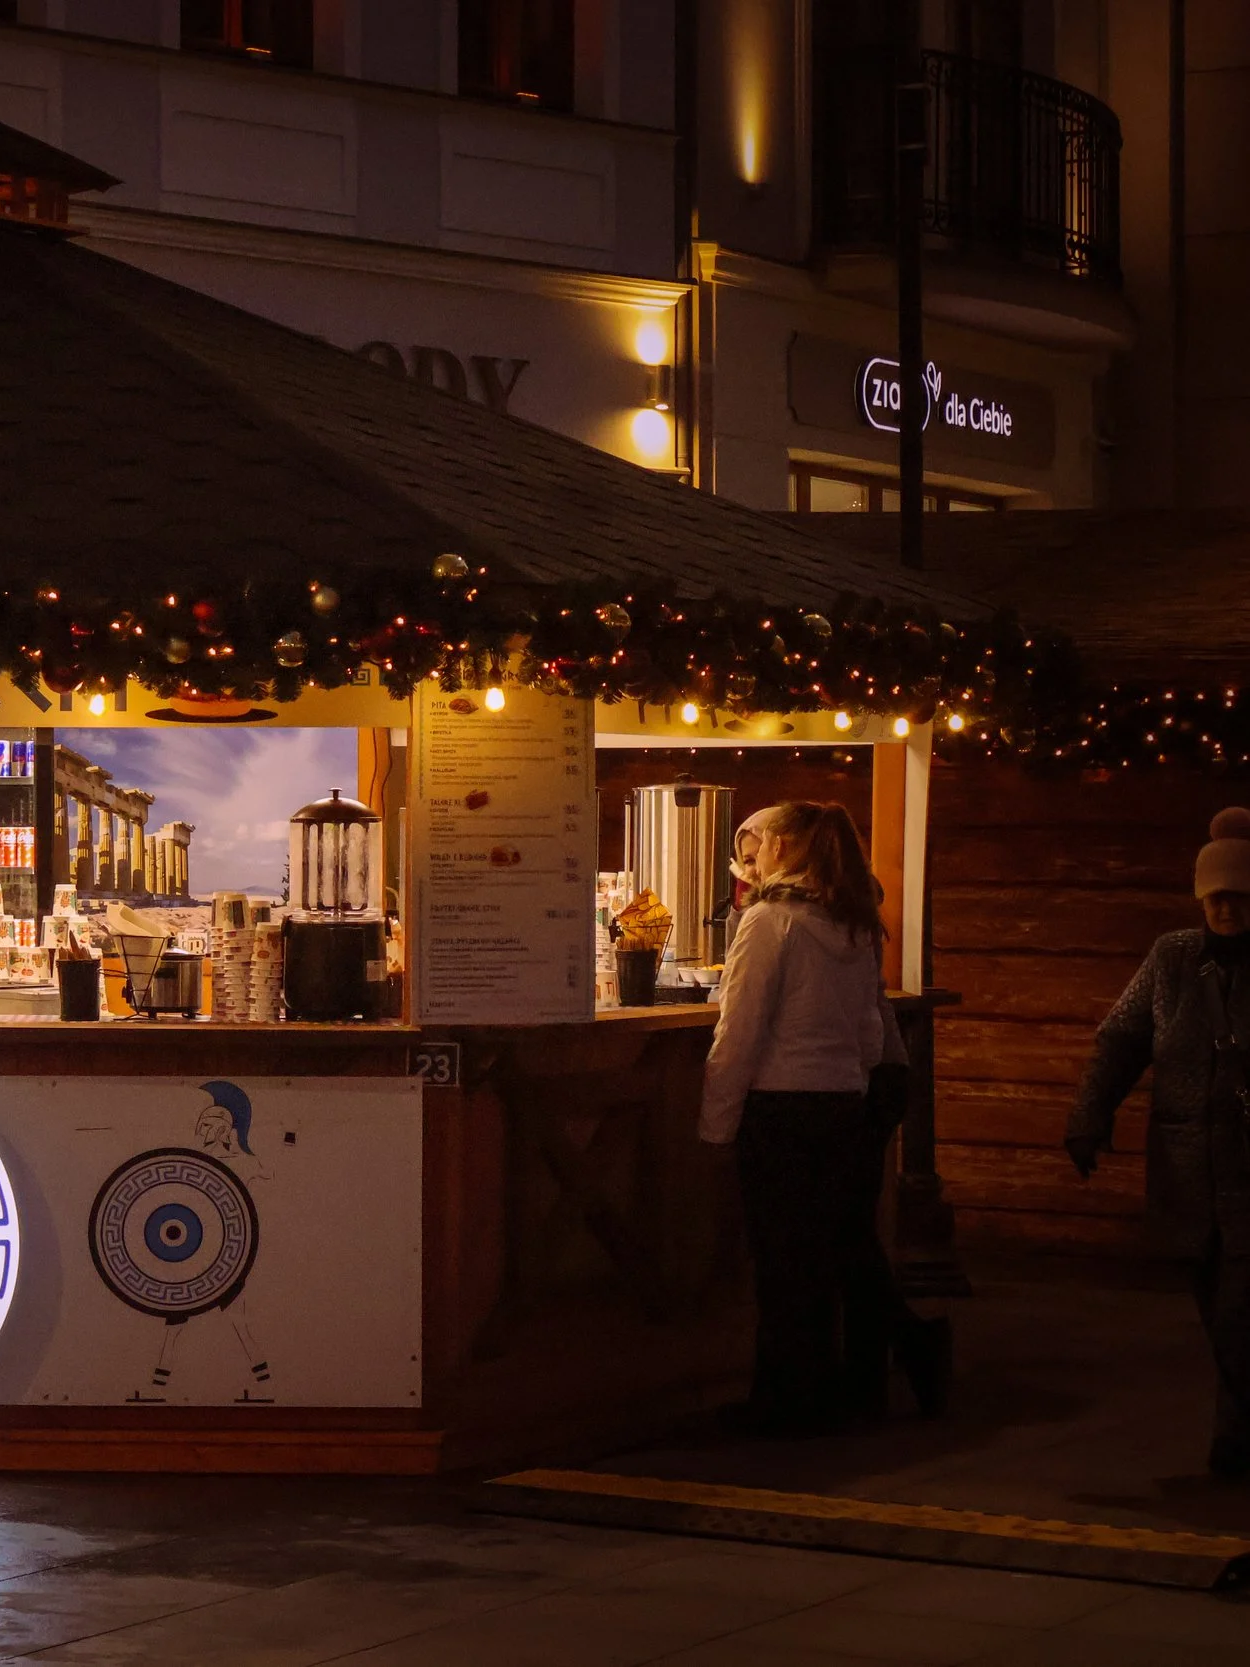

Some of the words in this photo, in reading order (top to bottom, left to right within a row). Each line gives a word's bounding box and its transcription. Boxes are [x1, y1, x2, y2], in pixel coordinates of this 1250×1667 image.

[945, 392, 967, 427] dla
[969, 397, 1012, 437] Ciebie
[431, 701, 447, 709] PITA
[416, 1054, 451, 1083] 23
